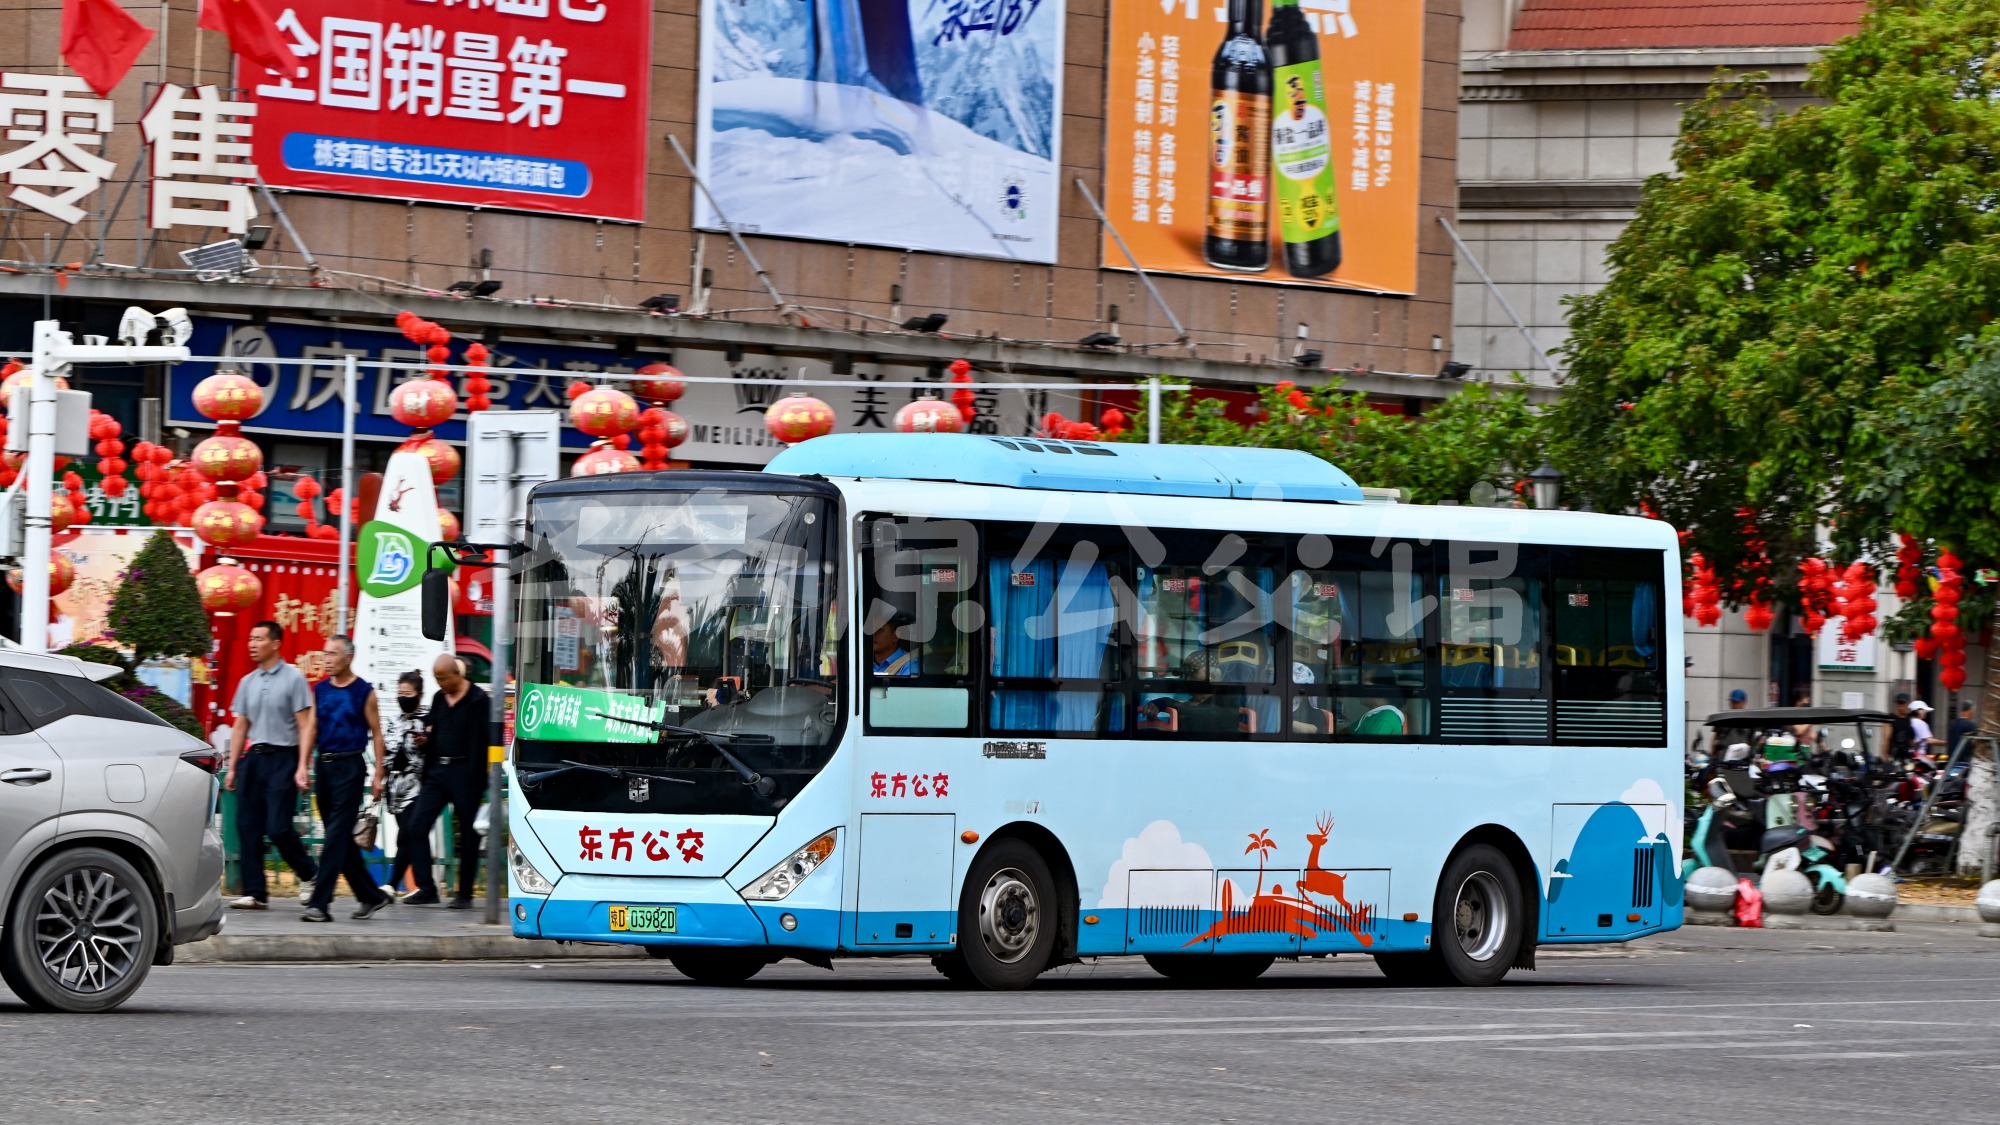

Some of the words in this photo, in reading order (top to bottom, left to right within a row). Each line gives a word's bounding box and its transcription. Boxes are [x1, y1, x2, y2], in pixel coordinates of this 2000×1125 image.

[256, 8, 627, 128] 全国销量第一
[1159, 35, 1180, 127] 轻松应对
[0, 71, 258, 234] 零售
[313, 138, 566, 189] 桃李面包专注15天以内短保面包
[1132, 129, 1153, 222] 特级酱油
[1156, 132, 1177, 225] 各种场合
[524, 694, 540, 727] 5
[543, 691, 582, 729] 东方动车站
[869, 771, 949, 798] 东方公交
[578, 825, 704, 864] 东方公交
